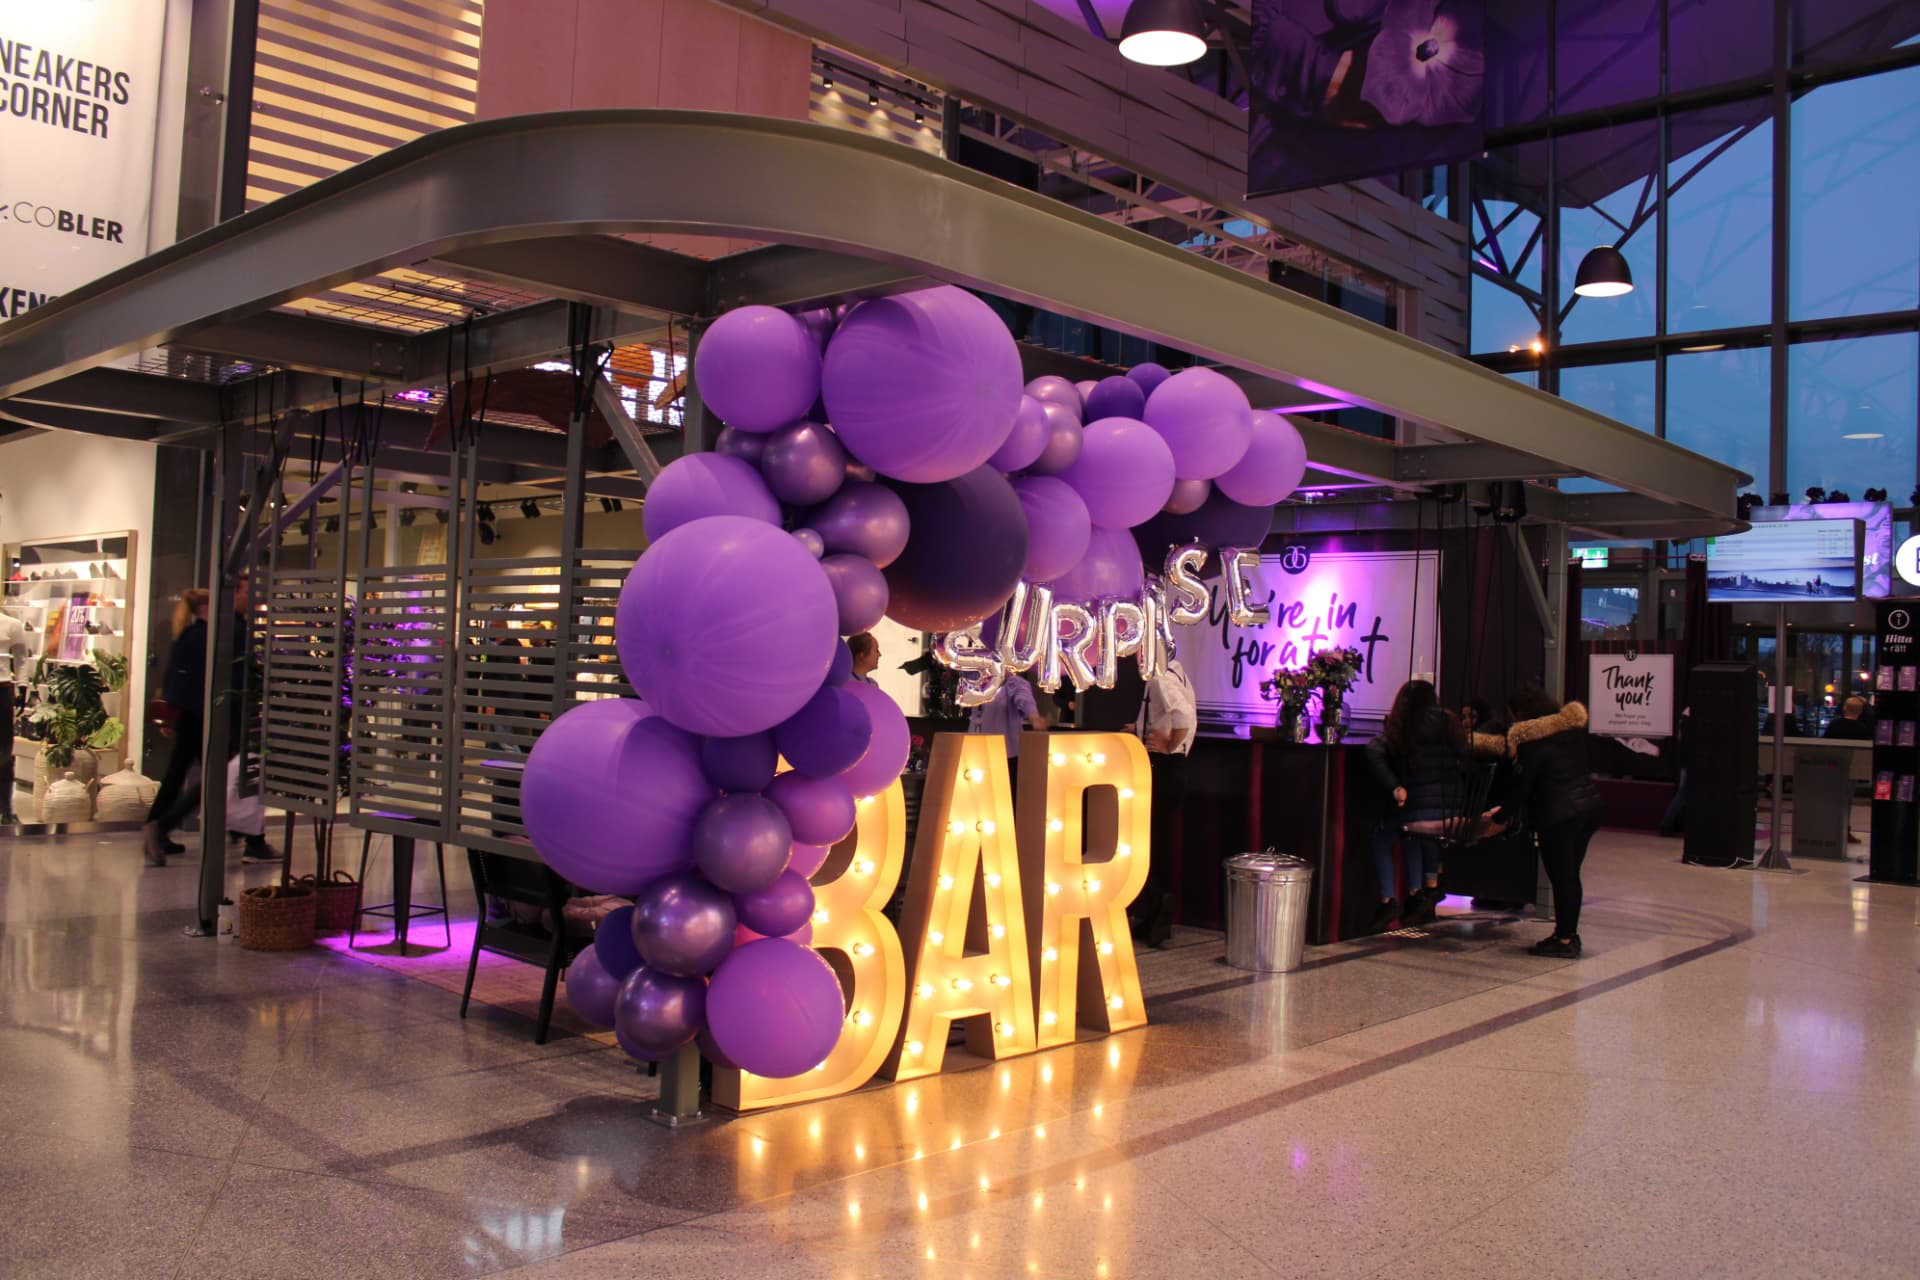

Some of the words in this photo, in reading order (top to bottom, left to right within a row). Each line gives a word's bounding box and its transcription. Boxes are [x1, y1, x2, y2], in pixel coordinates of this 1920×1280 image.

[1327, 592, 1357, 630] in
[1231, 636, 1275, 689] for
[1279, 643, 1298, 666] a
[1601, 665, 1655, 693] Thank
[1615, 690, 1653, 711] you!
[711, 731, 1153, 1113] BAR
